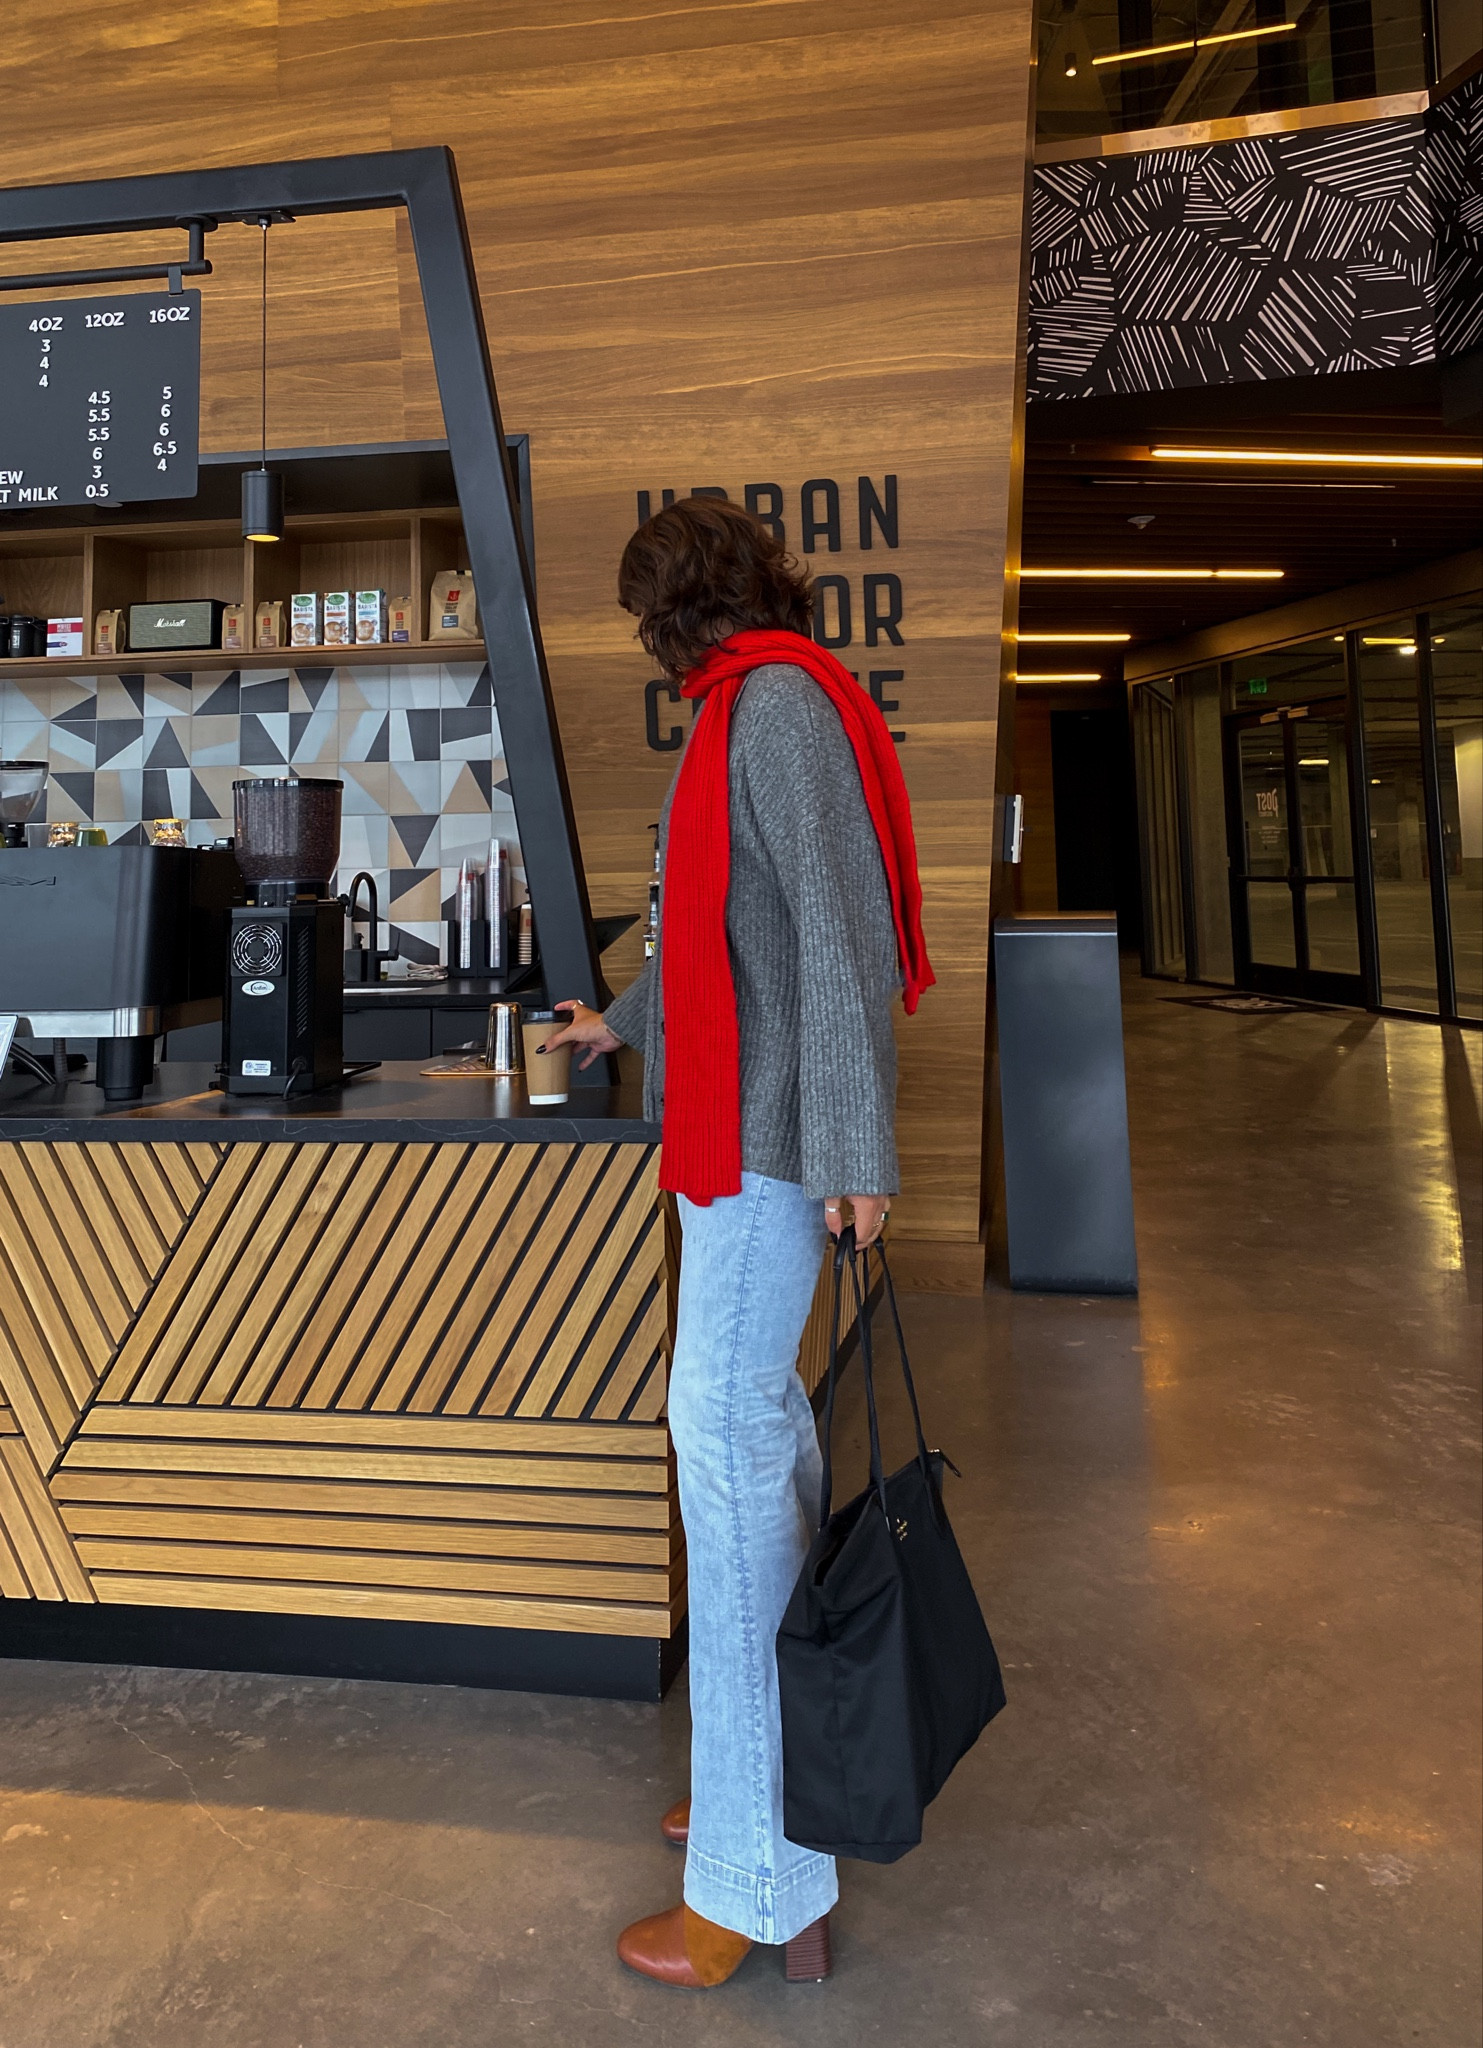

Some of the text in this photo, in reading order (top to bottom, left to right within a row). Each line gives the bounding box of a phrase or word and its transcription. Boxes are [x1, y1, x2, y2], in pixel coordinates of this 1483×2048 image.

[29, 306, 190, 332] 4OZ 12OZ 16OZ
[41, 339, 51, 352] 3
[39, 356, 50, 370] 4
[38, 374, 49, 388] 4
[88, 386, 172, 404] 4.5 5
[88, 404, 171, 422] 5.5 6
[87, 423, 169, 442] 5.5 6
[92, 441, 177, 460] 6 6.5
[92, 465, 102, 479] 3
[157, 458, 168, 472] 4
[0, 484, 109, 503] T MILK 0.5
[637, 474, 899, 553] BAN
[153, 617, 187, 628] Marshall
